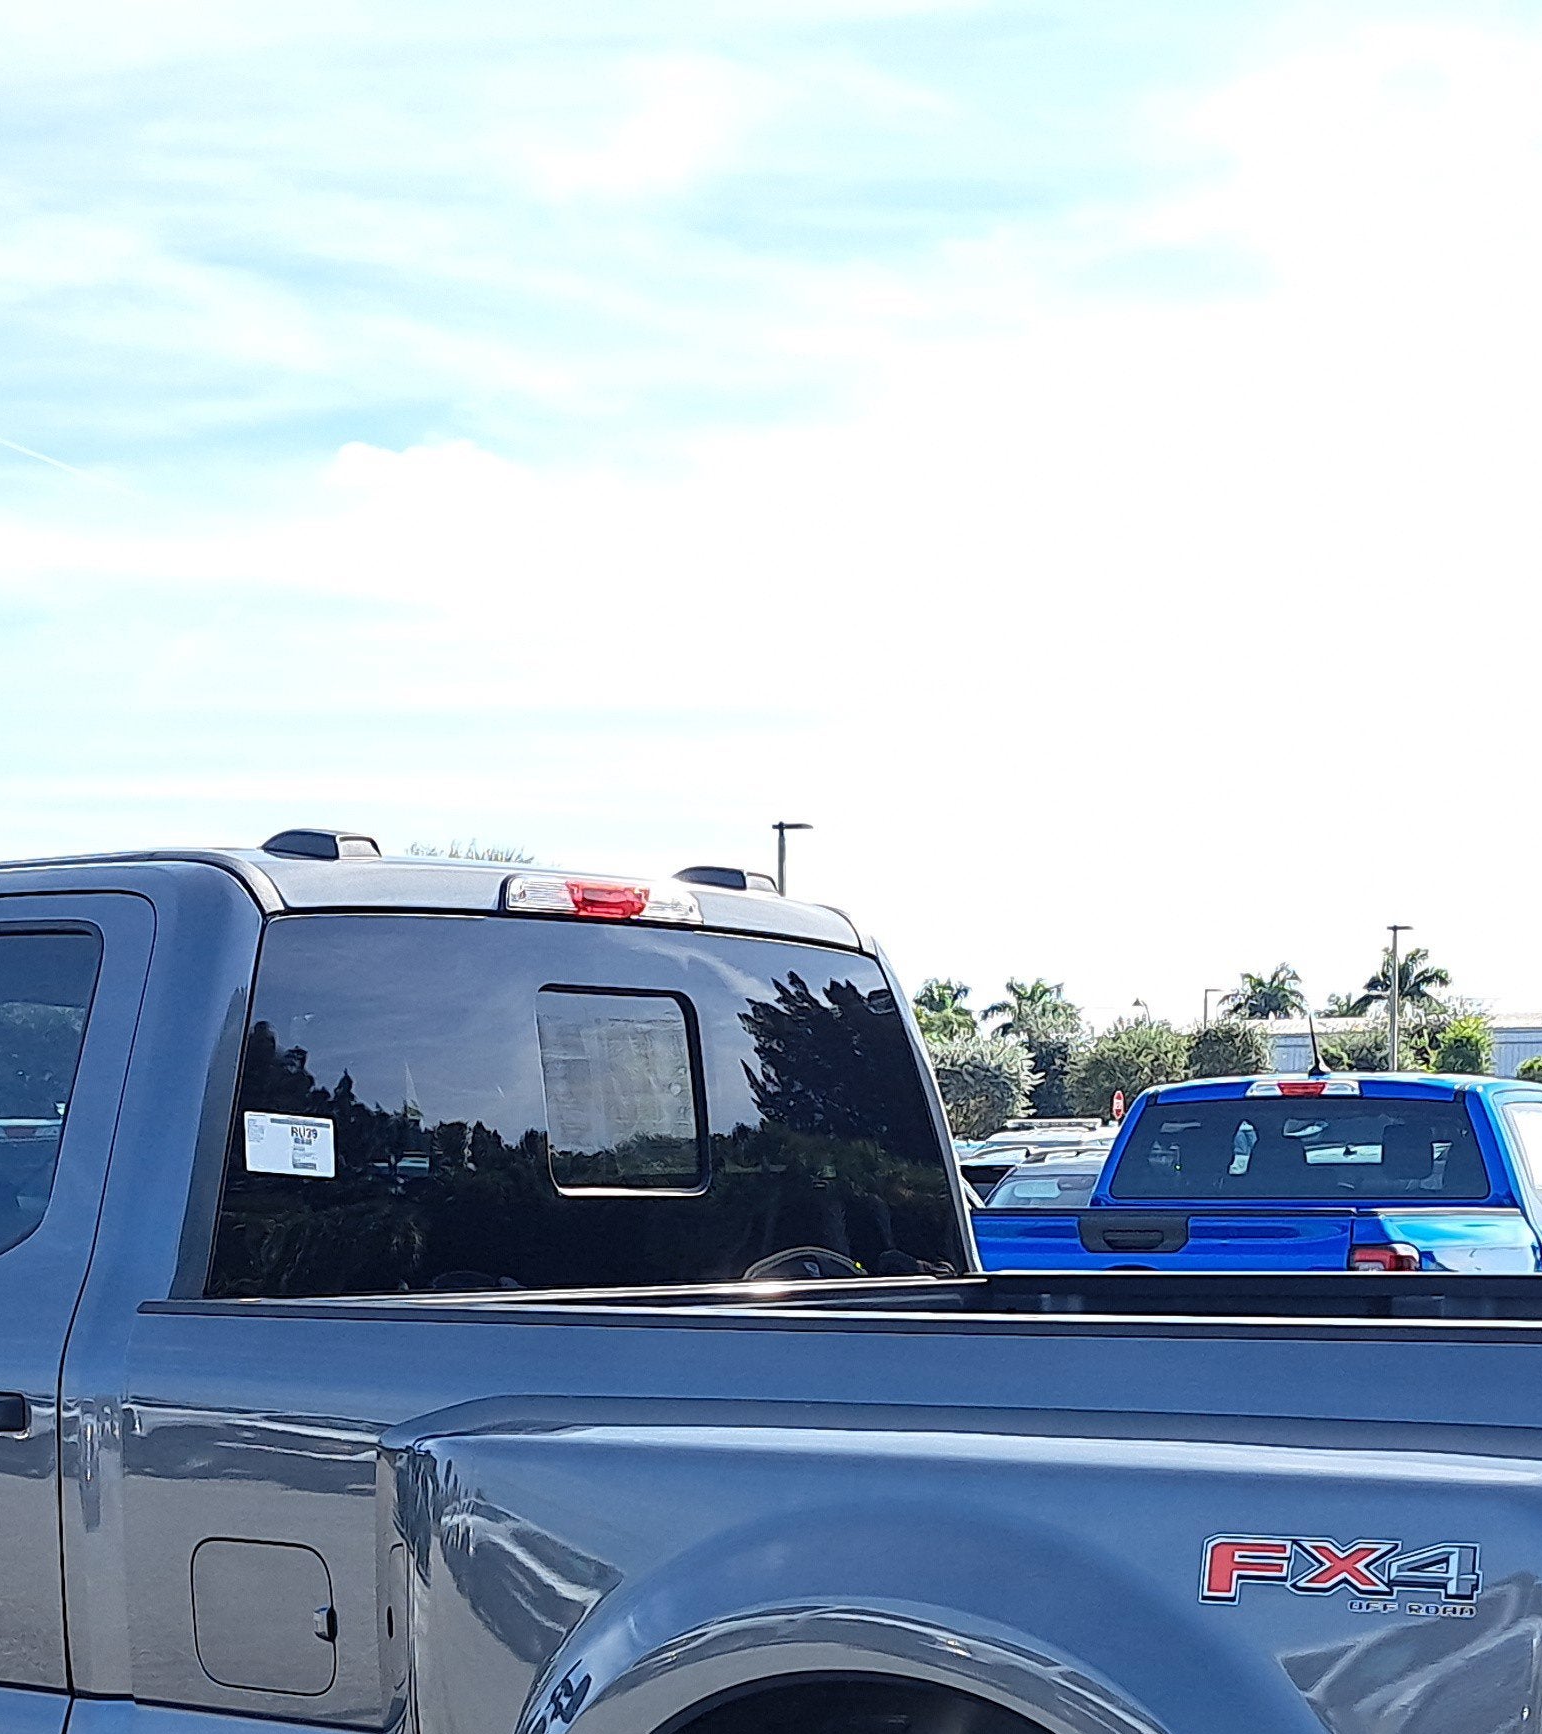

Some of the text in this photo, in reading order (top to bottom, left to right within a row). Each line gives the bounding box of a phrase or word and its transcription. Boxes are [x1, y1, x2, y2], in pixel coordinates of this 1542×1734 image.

[1199, 1533, 1483, 1605] FX4
[1348, 1600, 1477, 1618] OFF ROAD
